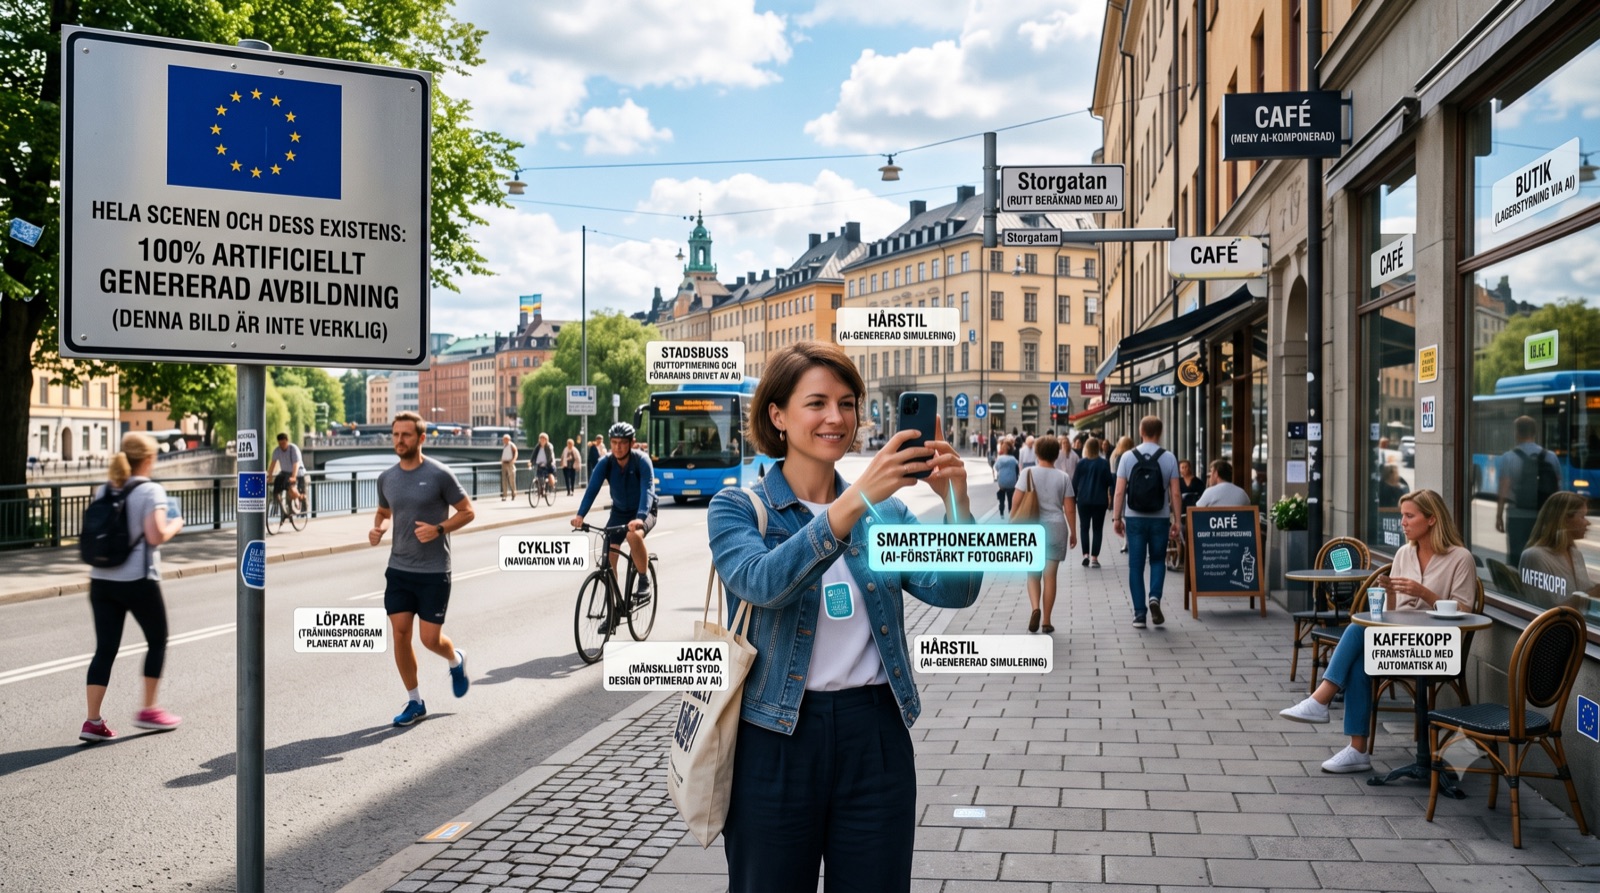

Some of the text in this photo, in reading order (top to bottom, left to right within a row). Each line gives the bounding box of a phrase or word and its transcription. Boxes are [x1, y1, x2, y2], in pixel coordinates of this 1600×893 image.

[1255, 99, 1311, 128] CAFÉ
[1231, 131, 1335, 145] (MENY AI-KOMPONERAD)
[1018, 172, 1107, 194] Storgatan
[1516, 159, 1552, 197] BUTIK
[1007, 193, 1118, 207] (RUTT BERÄKNAD MED AI)
[1494, 174, 1575, 227] (LAGERSTYRNING VIA AI)
[92, 200, 406, 242] HELA SCENEN OCH DESS EXISTENS:
[1007, 232, 1058, 244] Storgatam
[1190, 241, 1238, 264] CAFÉ
[138, 238, 366, 275] 100% ARTIFICIELLT
[1380, 241, 1404, 276] CAFÉ
[100, 268, 399, 309] GENERERAD AVBILDNING
[112, 308, 388, 343] (DENNA BILD ÄR INTE VERKLIG)
[1209, 514, 1238, 529] CAFÉ
